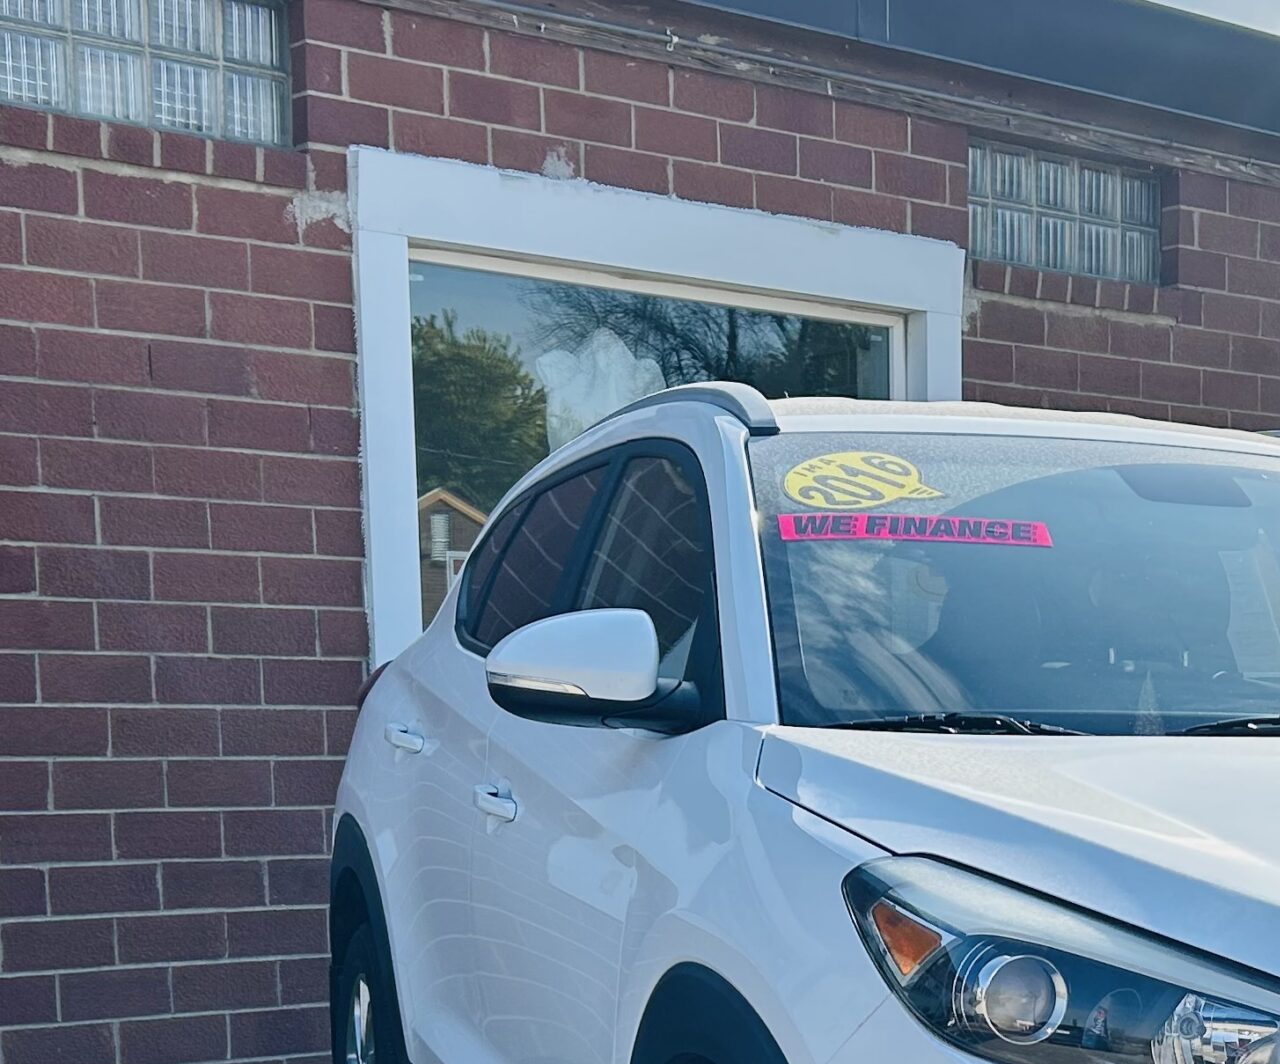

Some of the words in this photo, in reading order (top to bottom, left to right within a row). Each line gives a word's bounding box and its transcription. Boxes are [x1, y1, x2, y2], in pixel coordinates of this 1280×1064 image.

[798, 455, 912, 506] 2016
[793, 515, 857, 536] WE
[865, 515, 1036, 542] FINANCE
